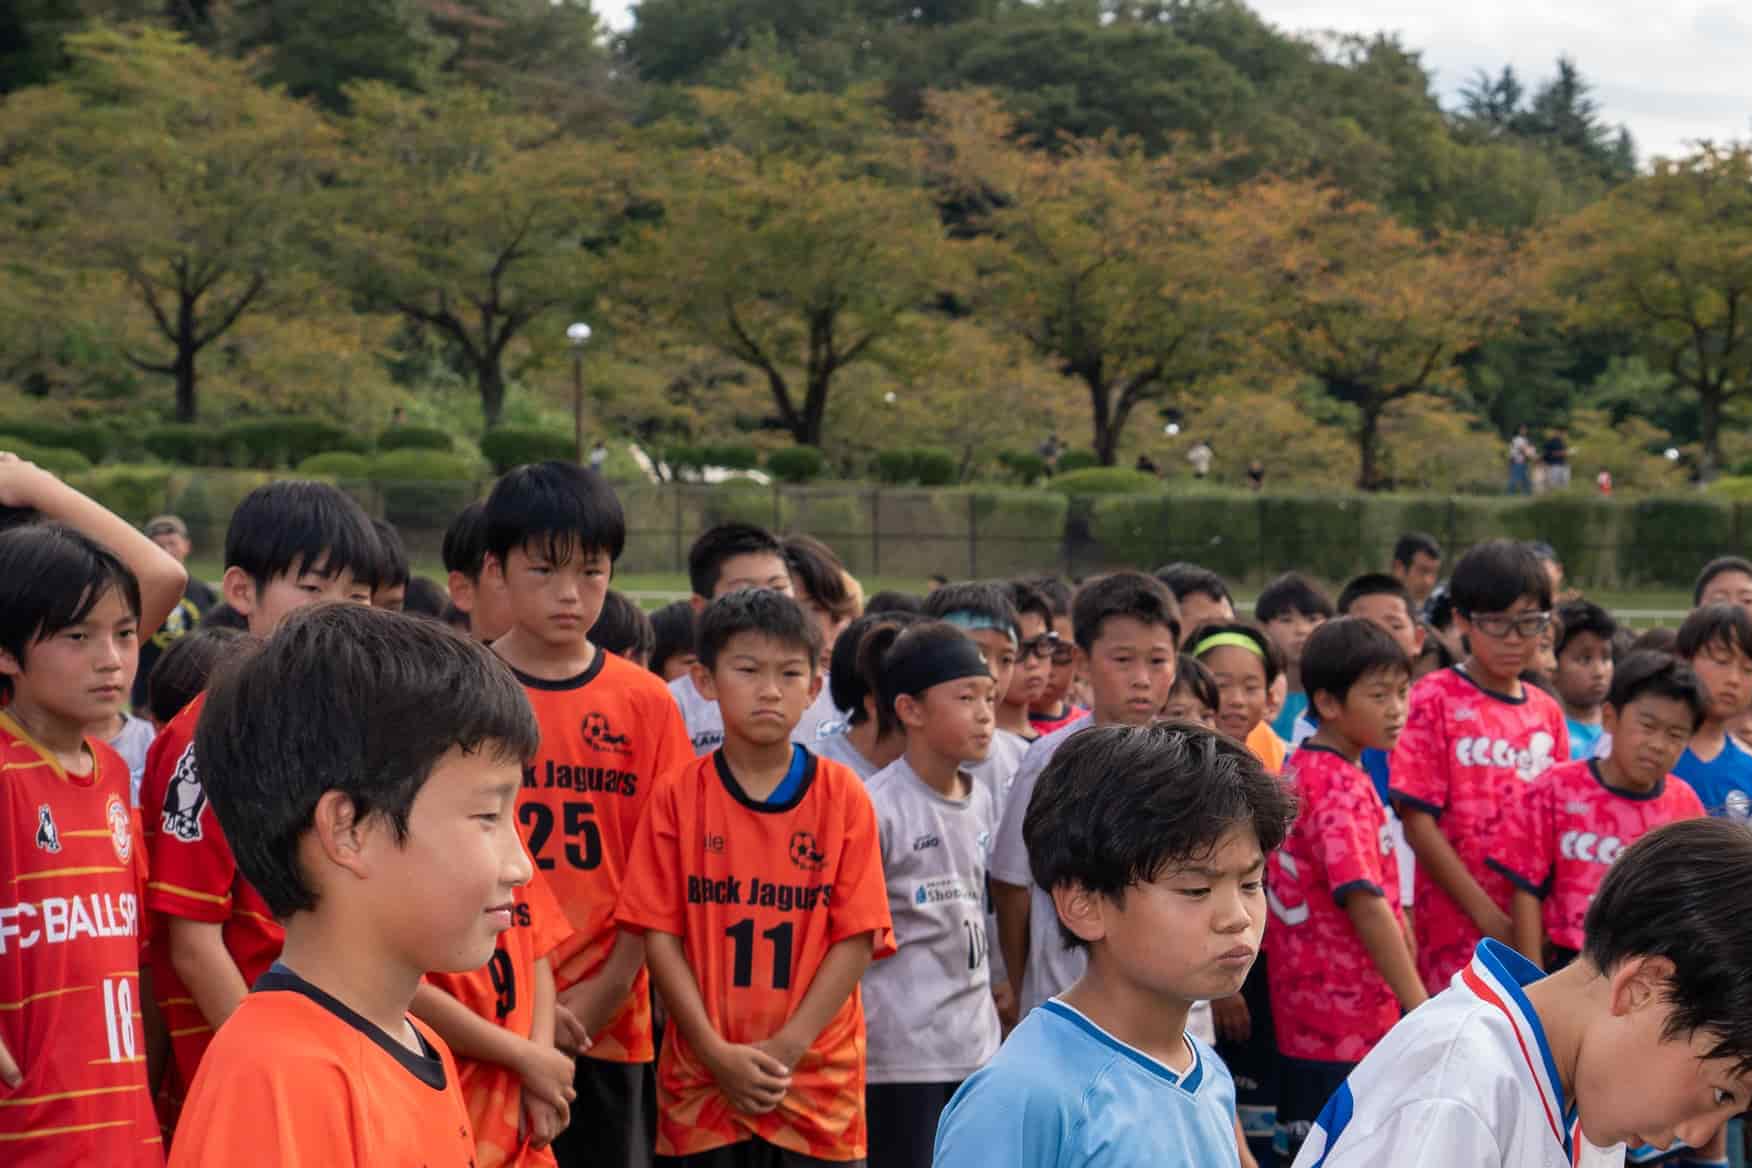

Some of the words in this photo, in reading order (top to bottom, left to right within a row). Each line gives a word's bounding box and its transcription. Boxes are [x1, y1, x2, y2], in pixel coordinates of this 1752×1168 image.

[544, 760, 638, 796] Jaguars
[519, 802, 602, 870] 25
[0, 901, 40, 954] FC
[725, 918, 793, 990] 11
[103, 979, 136, 1063] 18
